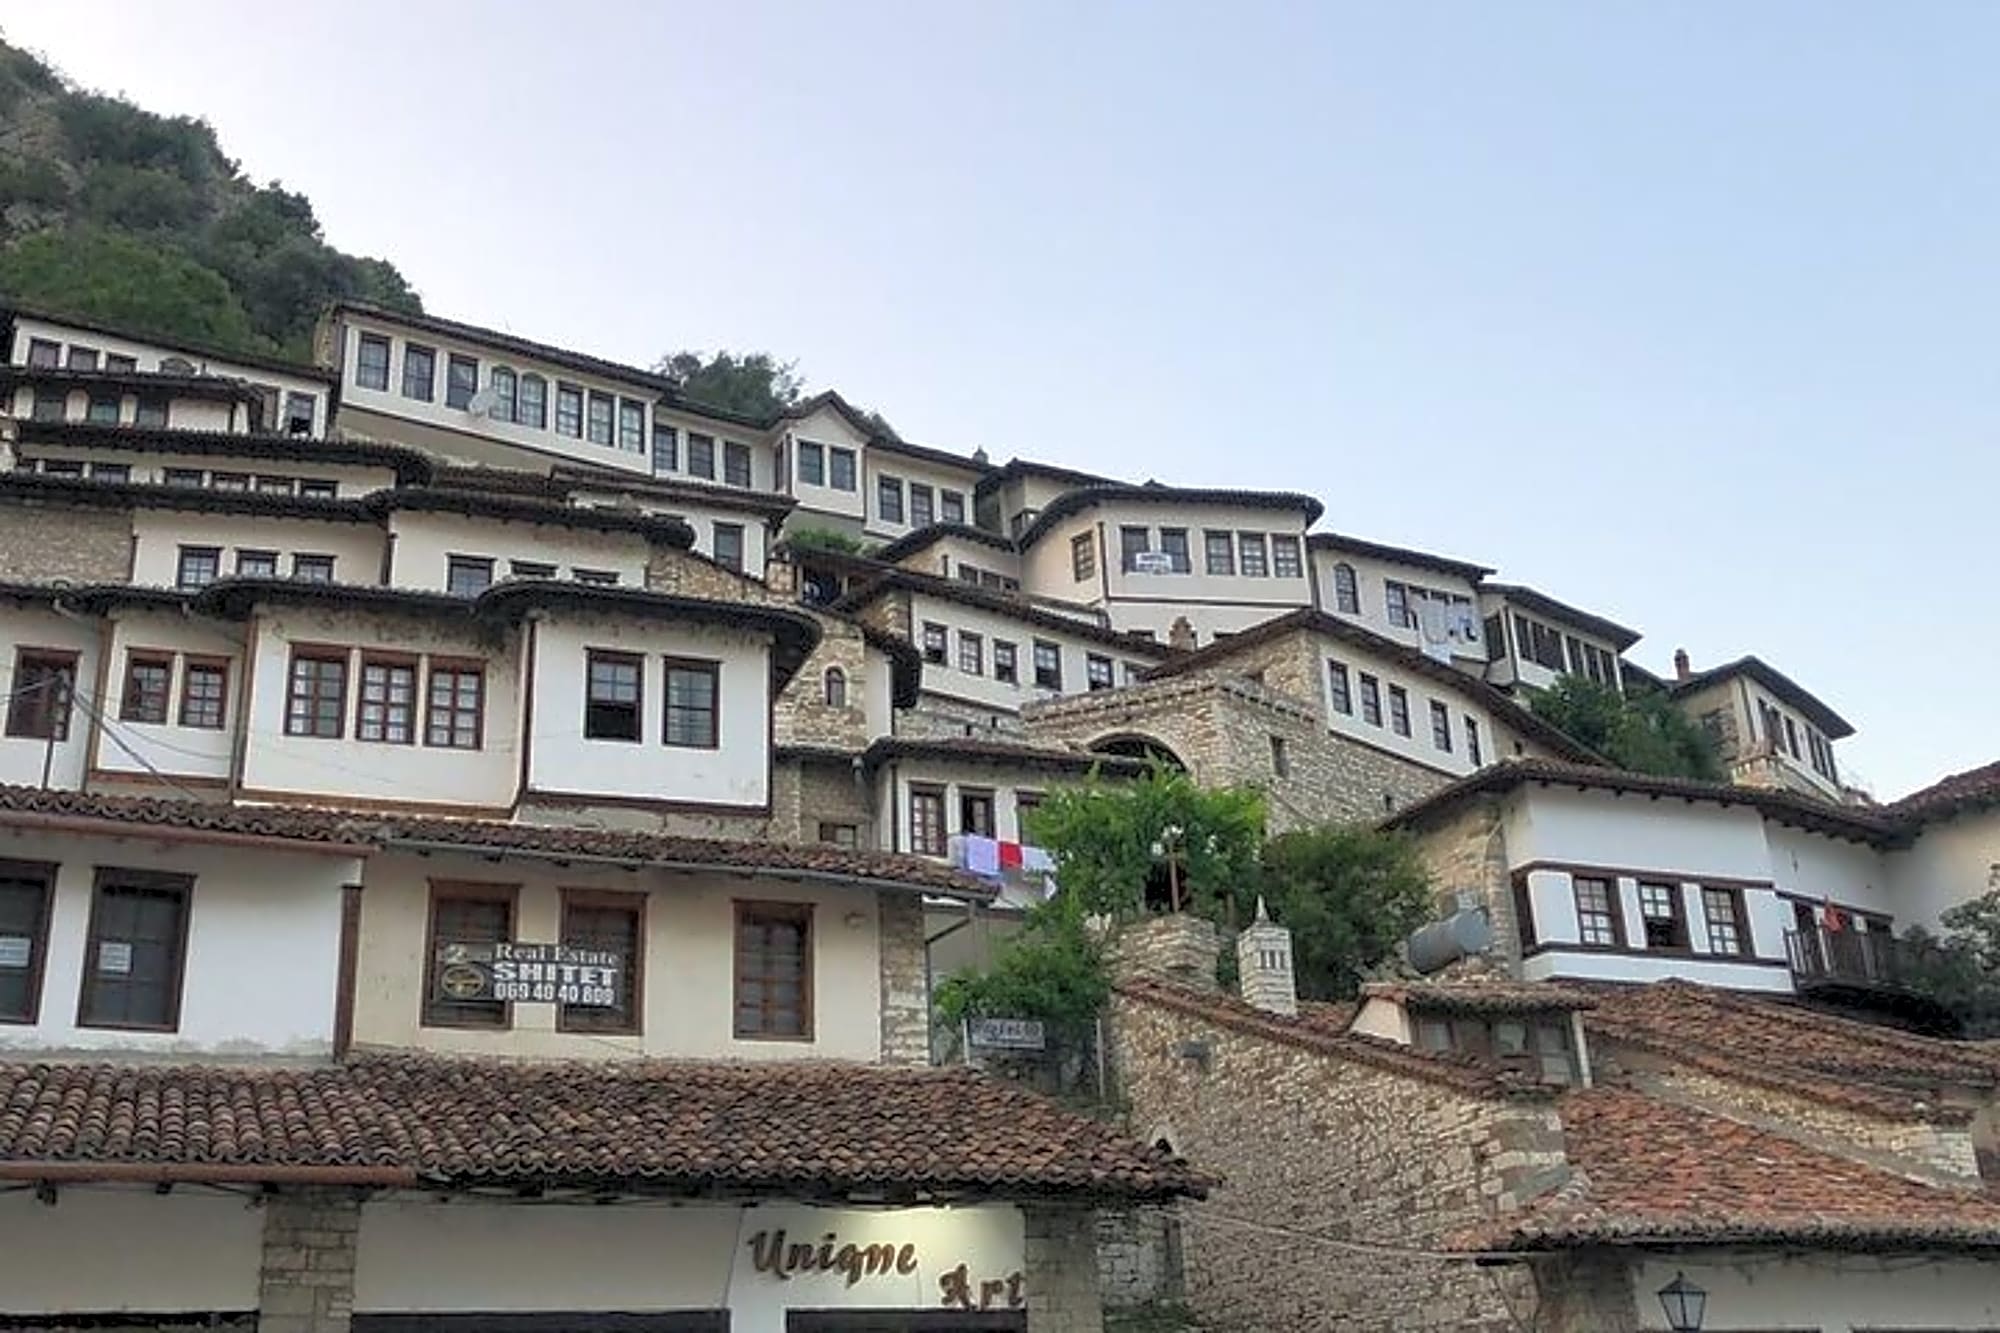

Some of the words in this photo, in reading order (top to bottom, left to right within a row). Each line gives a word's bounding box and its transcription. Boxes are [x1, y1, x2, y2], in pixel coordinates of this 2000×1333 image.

[496, 943, 545, 959] Real
[555, 946, 618, 965] Estate
[493, 961, 618, 986] SHITET
[494, 982, 529, 1000] 069
[558, 984, 579, 1003] 40
[939, 1263, 1024, 1311] Art
